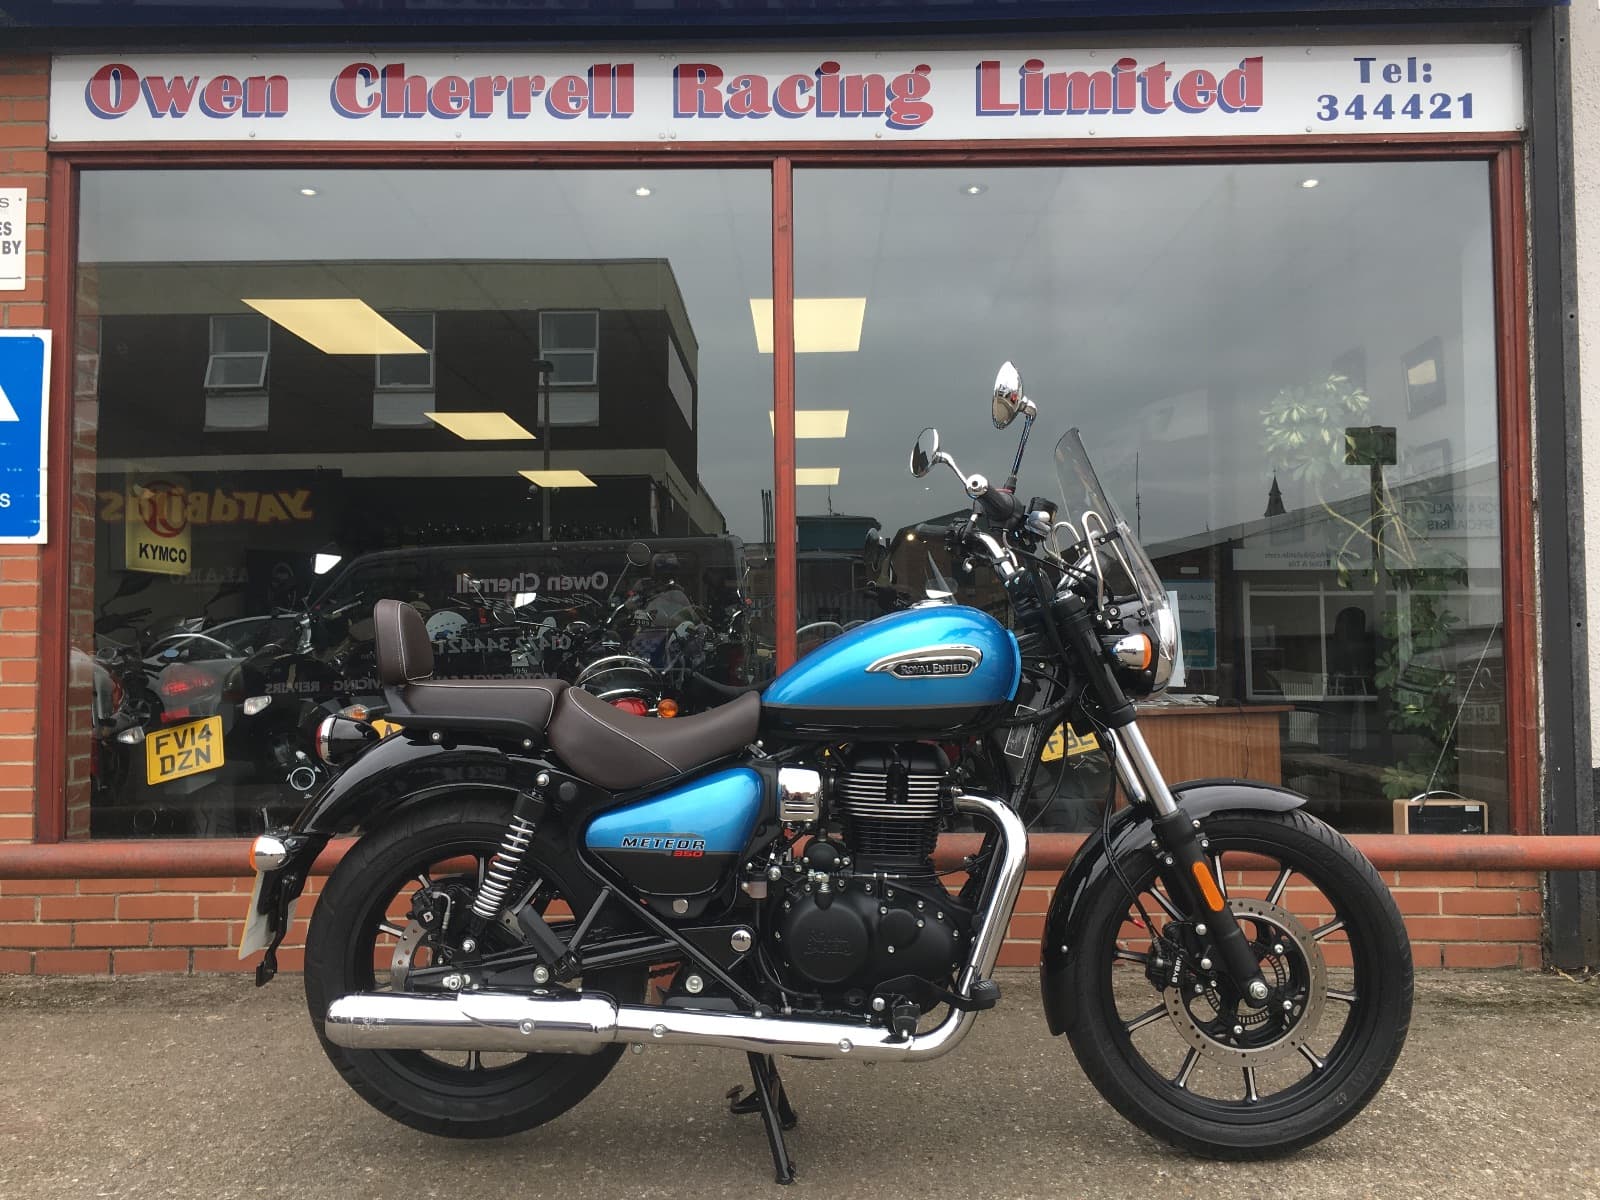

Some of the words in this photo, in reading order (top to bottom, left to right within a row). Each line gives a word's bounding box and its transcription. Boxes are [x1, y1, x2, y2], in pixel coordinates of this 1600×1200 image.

[1353, 57, 1433, 84] Tel:
[84, 61, 288, 119] Owen
[329, 61, 635, 119] Cherrell
[673, 59, 934, 129] Racing
[975, 56, 1264, 117] Limited
[1316, 92, 1474, 121] 344421
[2, 240, 22, 255] BY
[138, 542, 187, 564] KYMCO
[932, 663, 968, 673] ENFIELD
[155, 724, 212, 755] FV14
[160, 744, 211, 775] DZN
[621, 835, 705, 850] METEOR
[672, 850, 705, 858] 350
